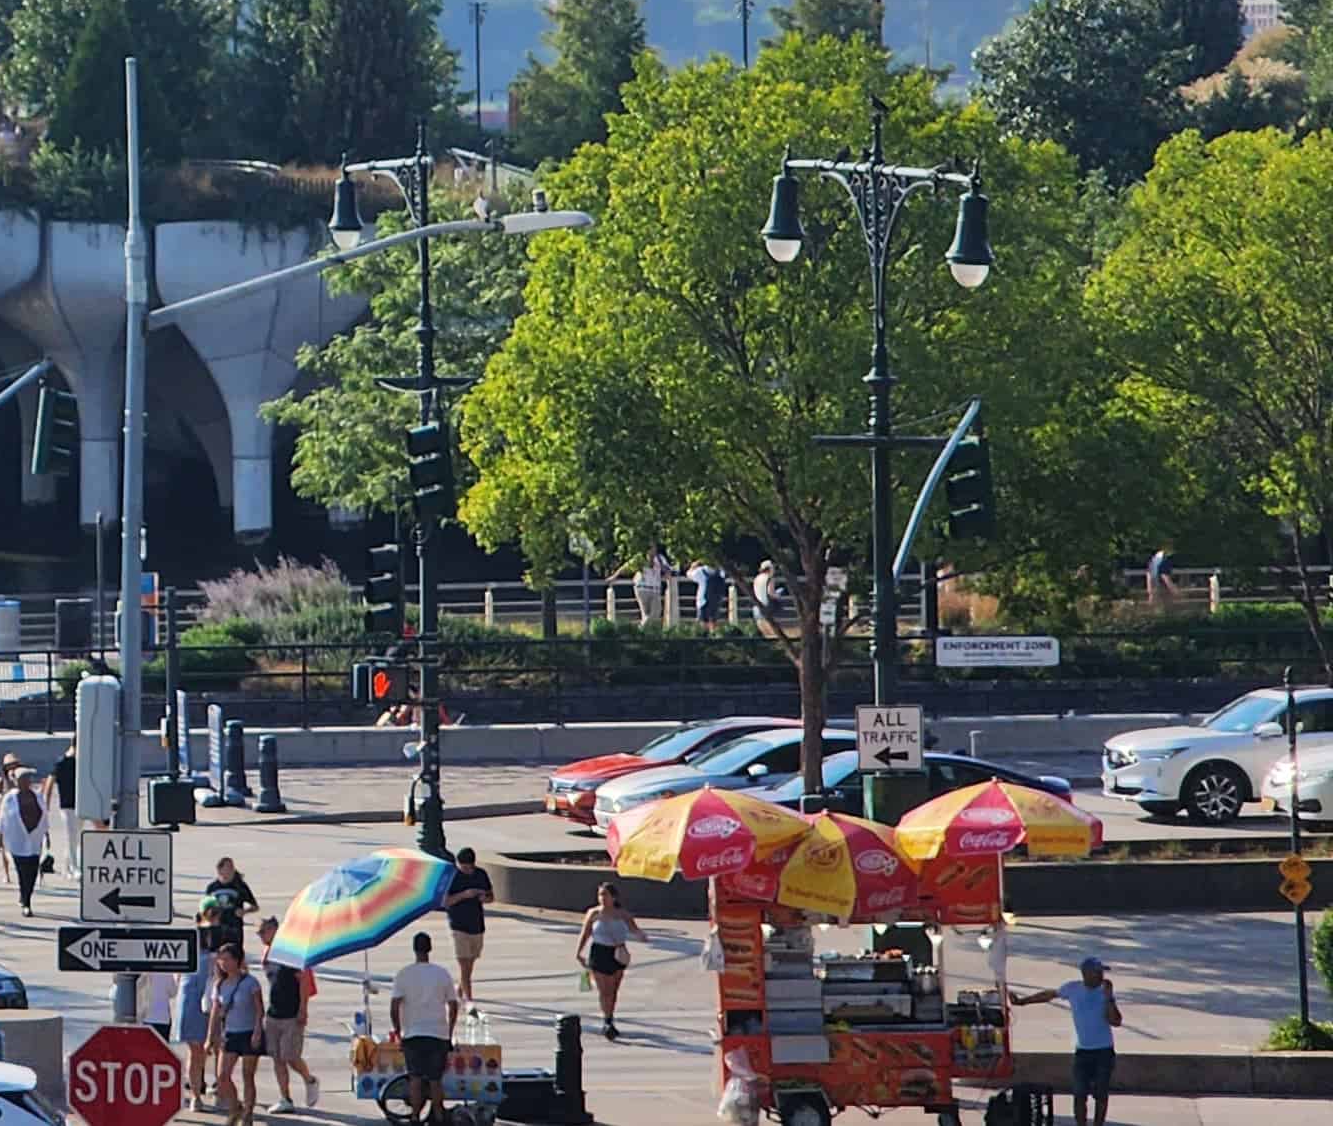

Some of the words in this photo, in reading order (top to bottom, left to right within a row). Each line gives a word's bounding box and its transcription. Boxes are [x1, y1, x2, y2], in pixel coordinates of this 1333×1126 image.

[943, 641, 1021, 650] ENFORCEMENT
[1025, 641, 1052, 650] ZONE
[874, 712, 909, 727] ALL
[861, 730, 918, 744] TRAFFIC
[102, 838, 152, 860] ALL
[87, 866, 166, 885] TRAFFIC
[82, 941, 117, 959] ONE
[144, 942, 182, 959] WAY
[74, 1060, 176, 1105] STOP
